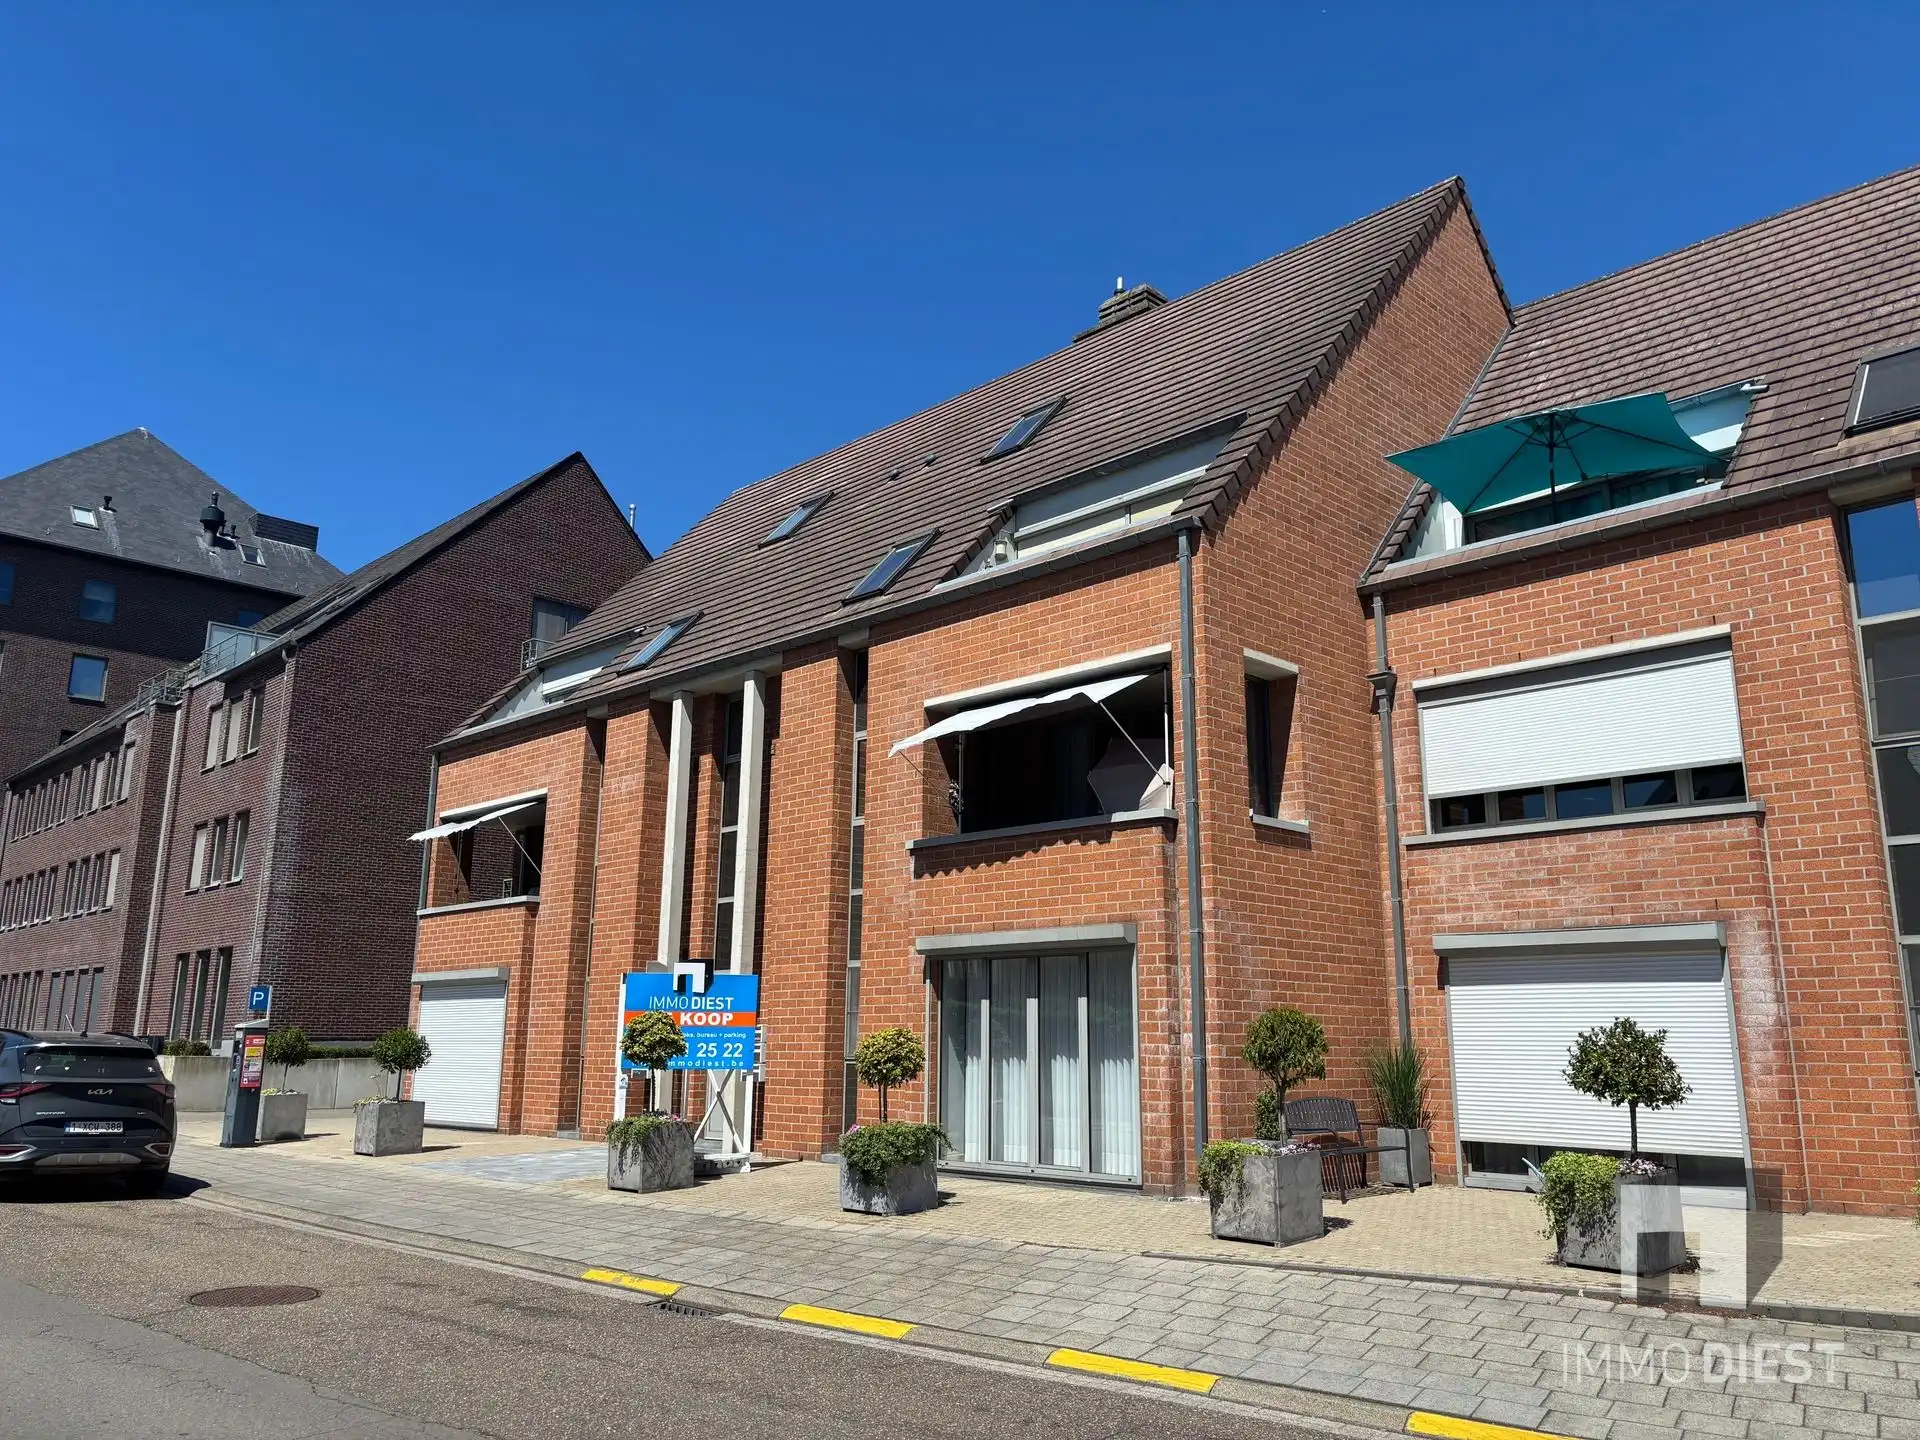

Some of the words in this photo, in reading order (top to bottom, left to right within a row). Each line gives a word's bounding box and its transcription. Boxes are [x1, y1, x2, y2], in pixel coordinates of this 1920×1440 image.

[253, 992, 264, 1005] P
[649, 996, 689, 1010] IMMO
[691, 997, 734, 1010] DIEST
[680, 1012, 734, 1025] KOOP
[696, 1042, 718, 1058] 25
[722, 1042, 743, 1058] 22
